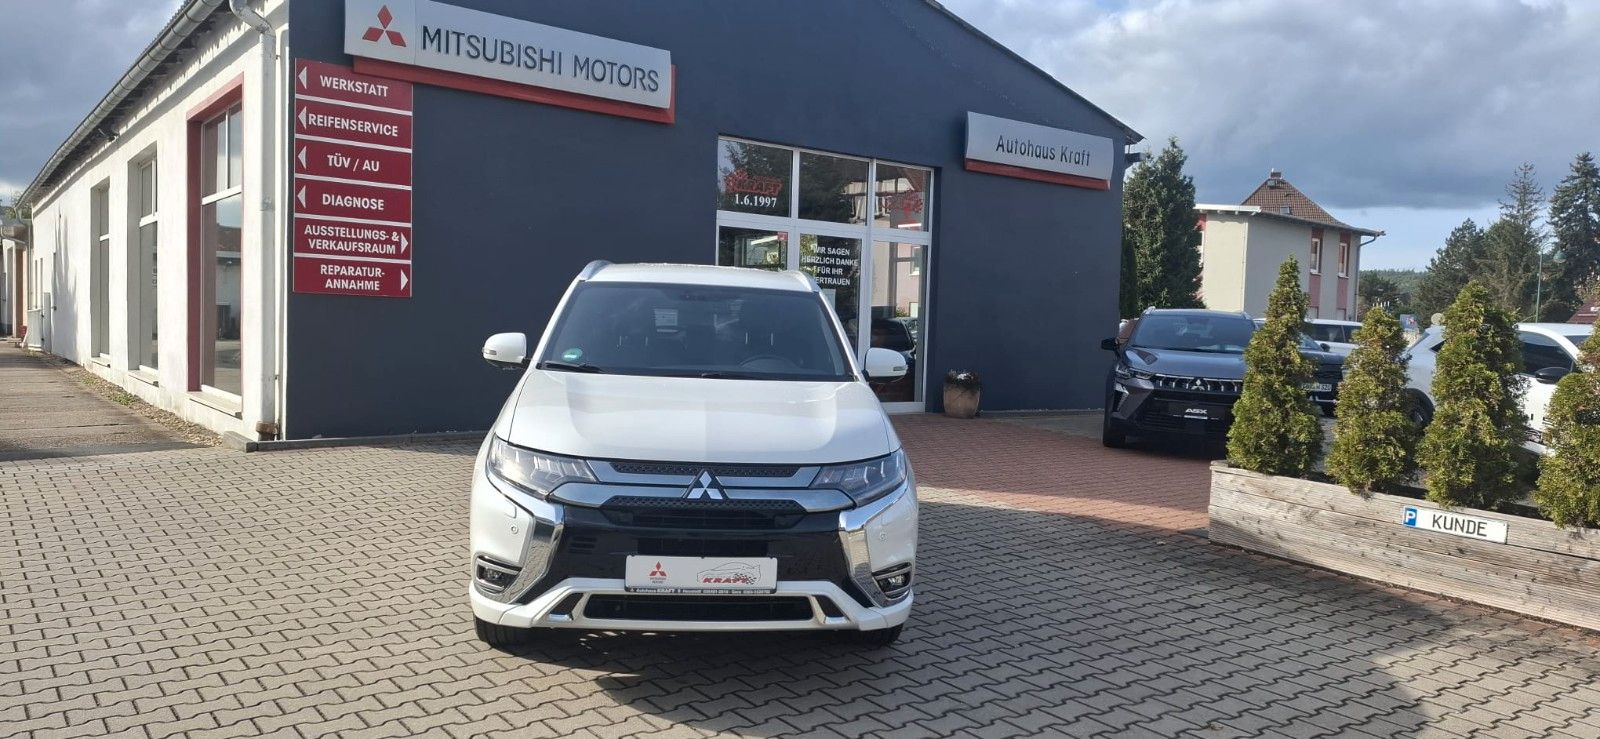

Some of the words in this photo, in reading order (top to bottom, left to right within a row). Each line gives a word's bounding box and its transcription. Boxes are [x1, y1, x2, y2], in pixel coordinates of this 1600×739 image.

[422, 25, 563, 75] MITSUBISHI
[573, 55, 659, 92] MOTORS
[319, 74, 389, 97] WERKSTATT
[308, 113, 399, 137] REIFENSERVICE
[996, 135, 1056, 160] Autohaus
[1060, 145, 1091, 166] Kraft
[327, 152, 351, 169] TÜV
[362, 159, 380, 172] AU
[322, 193, 385, 211] DIAGNOSE
[734, 193, 777, 208] 1.6.1997
[304, 224, 389, 240] AUSSTELLUNGS-
[308, 238, 396, 255] VERKAUFSRAUM
[812, 246, 826, 254] WIR
[827, 247, 850, 256] SAGEN
[801, 255, 835, 265] HERZLICH
[835, 258, 858, 266] DANKE
[320, 264, 386, 277] REPARATUR-
[832, 267, 843, 275] IHR
[325, 278, 380, 291] ANNAHME
[814, 276, 851, 285] ERTRAUEN
[1405, 511, 1416, 523] P
[1431, 514, 1488, 537] KUNDE
